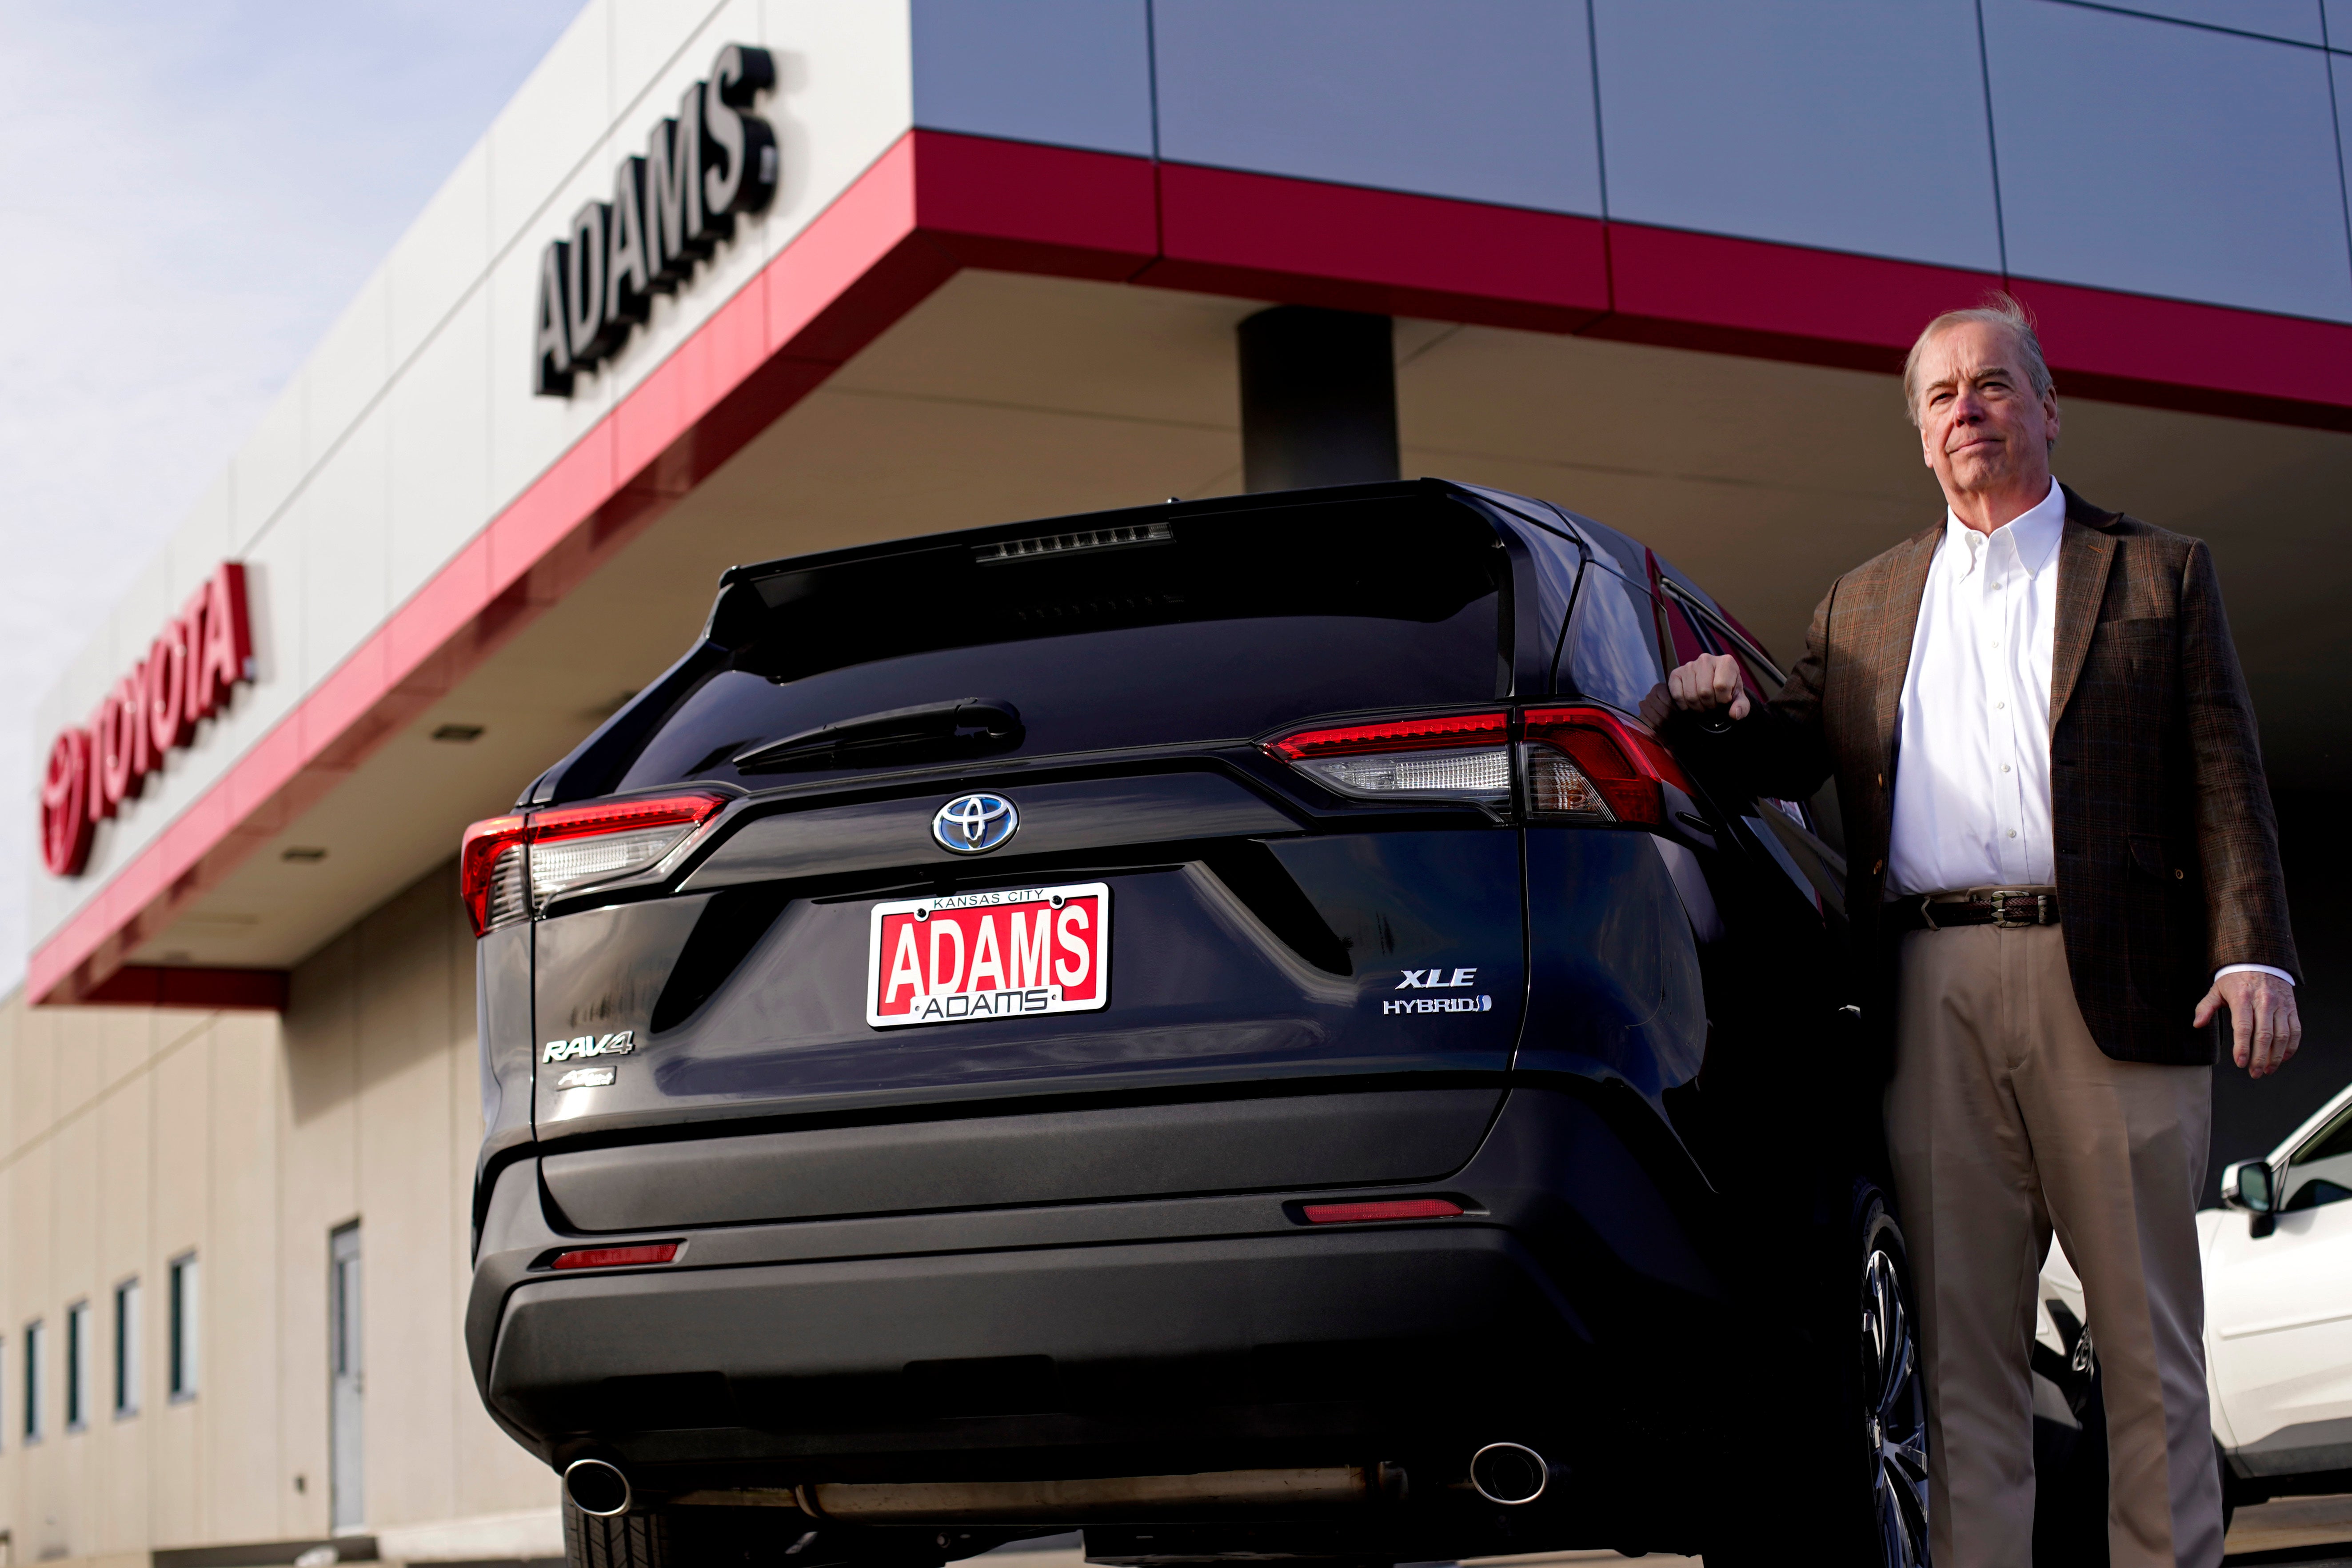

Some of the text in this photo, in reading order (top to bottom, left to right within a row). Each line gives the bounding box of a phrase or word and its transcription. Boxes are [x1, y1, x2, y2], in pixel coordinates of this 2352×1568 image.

[534, 43, 778, 397] ADAMS
[88, 562, 254, 823] TOYOTA
[934, 889, 1044, 909] KANSAS CITY
[885, 905, 1090, 1004] ADAMS
[1394, 968, 1477, 990] XLE
[921, 989, 1048, 1020] ADAMS
[1383, 998, 1474, 1015] HYBRID
[542, 1030, 633, 1064] RAV4
